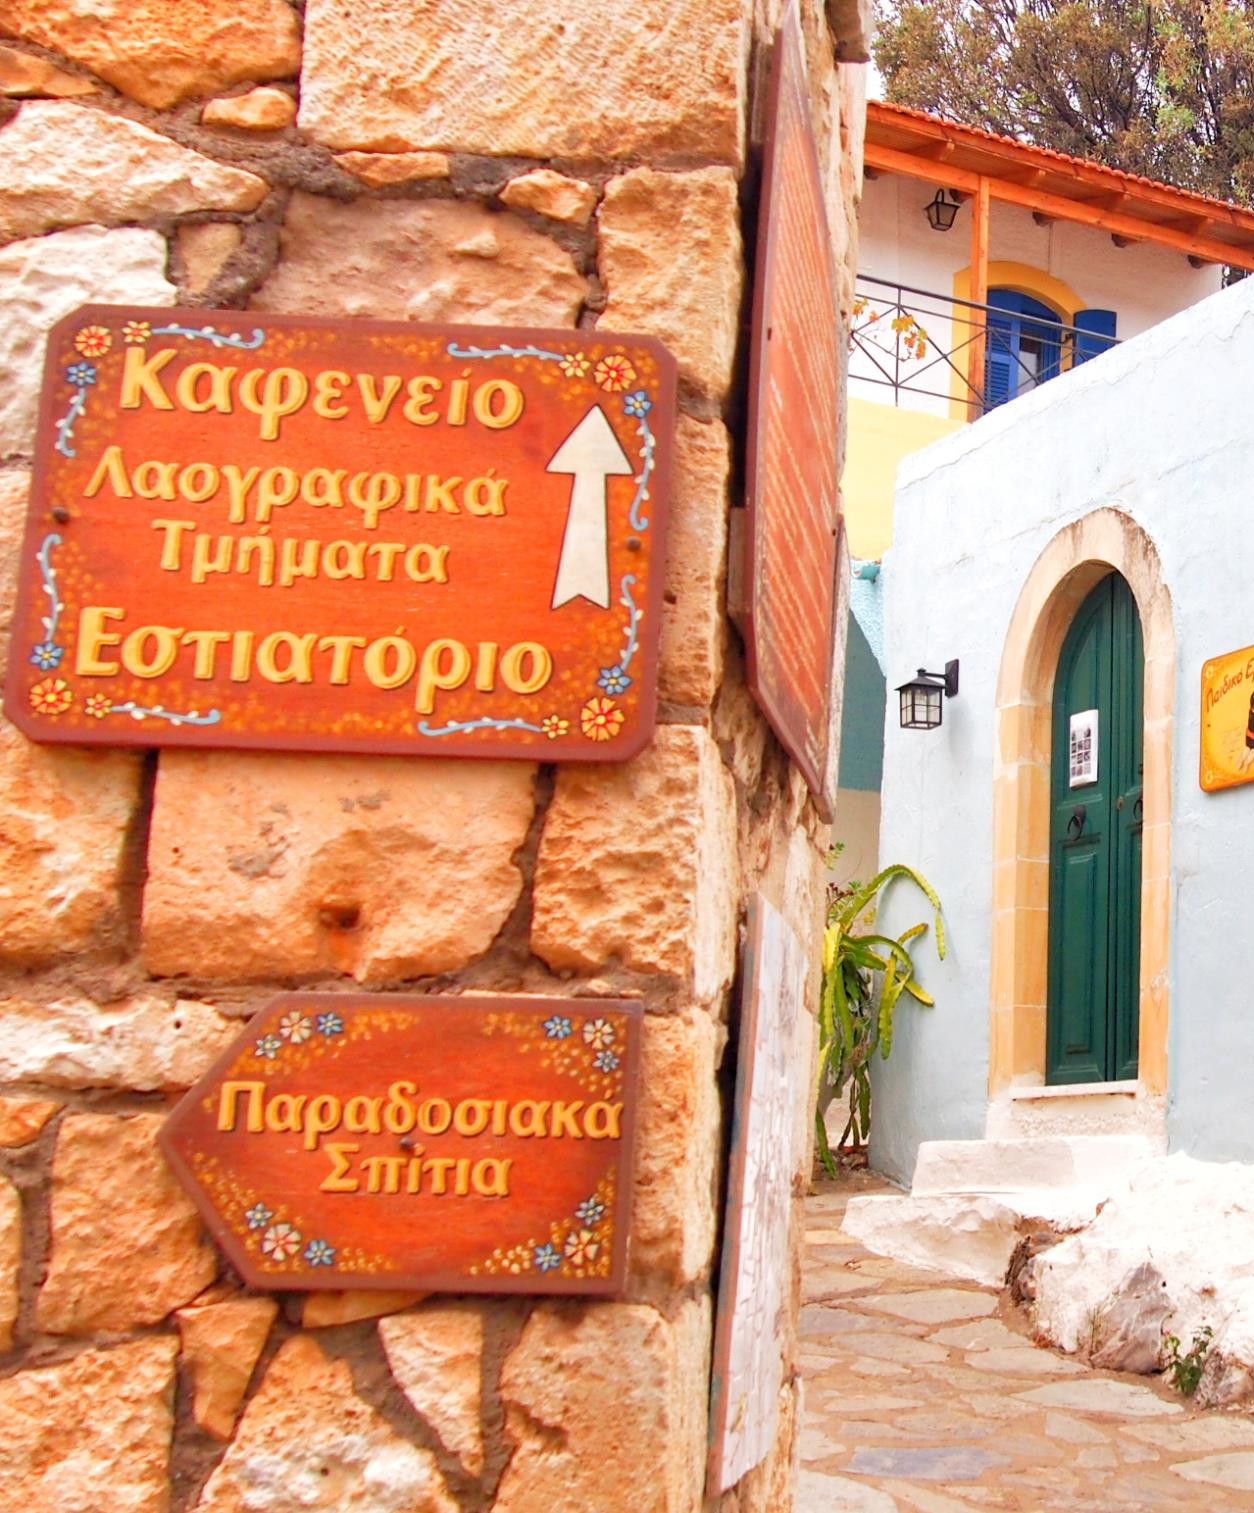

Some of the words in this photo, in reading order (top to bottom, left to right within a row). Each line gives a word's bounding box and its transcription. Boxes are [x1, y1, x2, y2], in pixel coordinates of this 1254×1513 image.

[120, 346, 524, 440] Καφενείο
[83, 446, 508, 528] Λαογραφικά
[153, 519, 450, 586] Τμήματα
[75, 606, 553, 714] Εστιατόριο
[217, 1080, 624, 1150] Παραδοσιακά
[320, 1143, 512, 1196] Σπίτια
